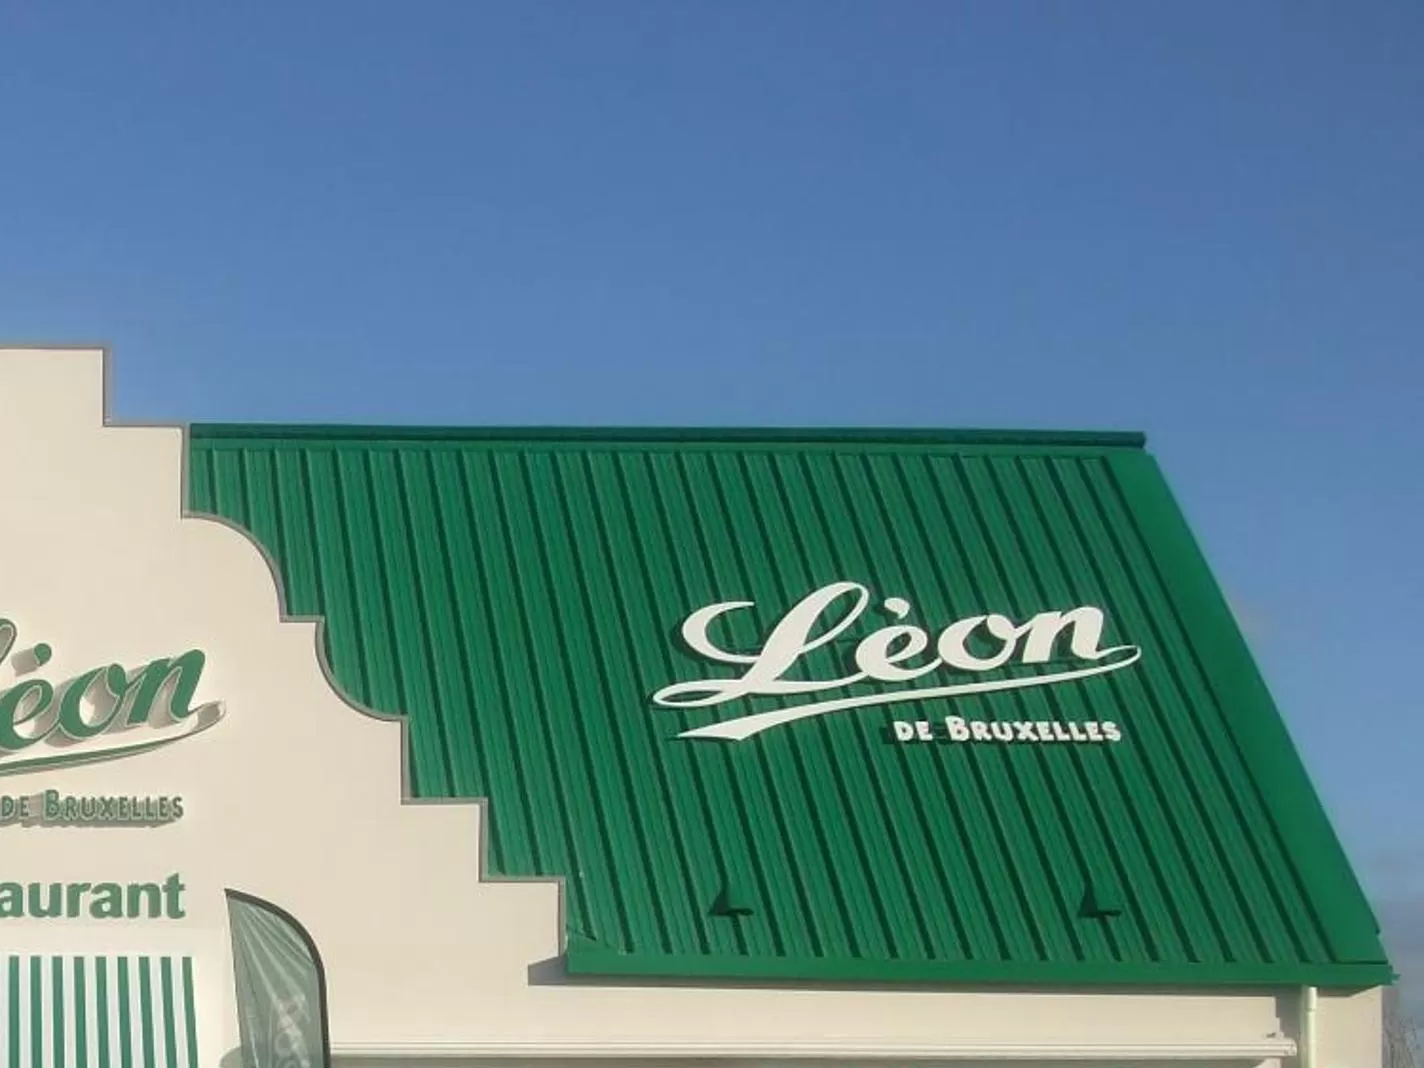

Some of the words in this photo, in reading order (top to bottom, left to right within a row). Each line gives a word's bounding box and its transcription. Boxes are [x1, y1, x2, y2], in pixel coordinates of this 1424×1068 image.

[653, 581, 1141, 740] Léon
[892, 720, 933, 742] DE
[945, 714, 1122, 742] BRUXELLES
[0, 795, 29, 820] DE
[43, 788, 185, 821] BRUXELLES
